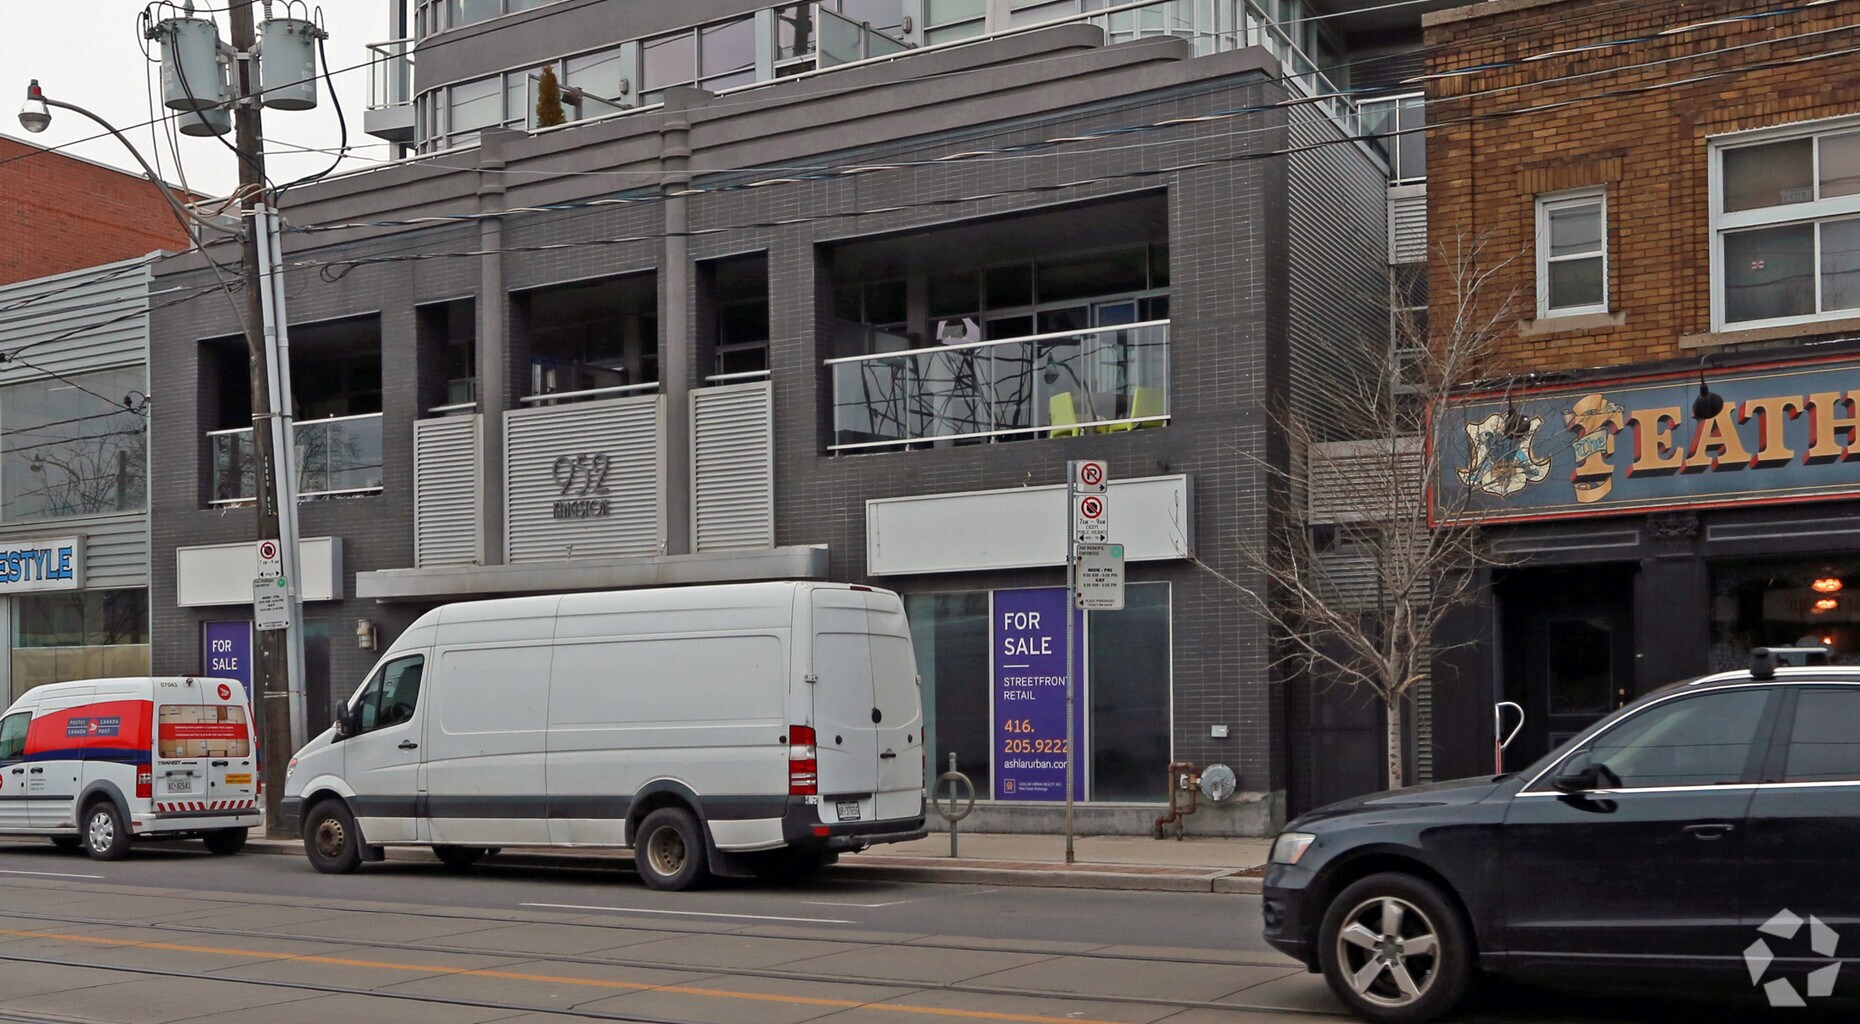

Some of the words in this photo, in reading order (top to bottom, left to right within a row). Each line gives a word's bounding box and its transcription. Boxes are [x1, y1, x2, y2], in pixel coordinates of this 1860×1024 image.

[1576, 436, 1605, 456] The
[552, 452, 610, 495] 952
[0, 546, 72, 583] ESTYLE
[1004, 612, 1040, 630] FOR
[212, 639, 232, 652] FOR
[1004, 637, 1052, 656] SALE
[212, 658, 238, 671] SALE
[1003, 676, 1067, 687] STREETFRON
[1003, 691, 1035, 700] RETAIL
[1004, 719, 1035, 733] 416.
[1004, 739, 1068, 753] 205.9222
